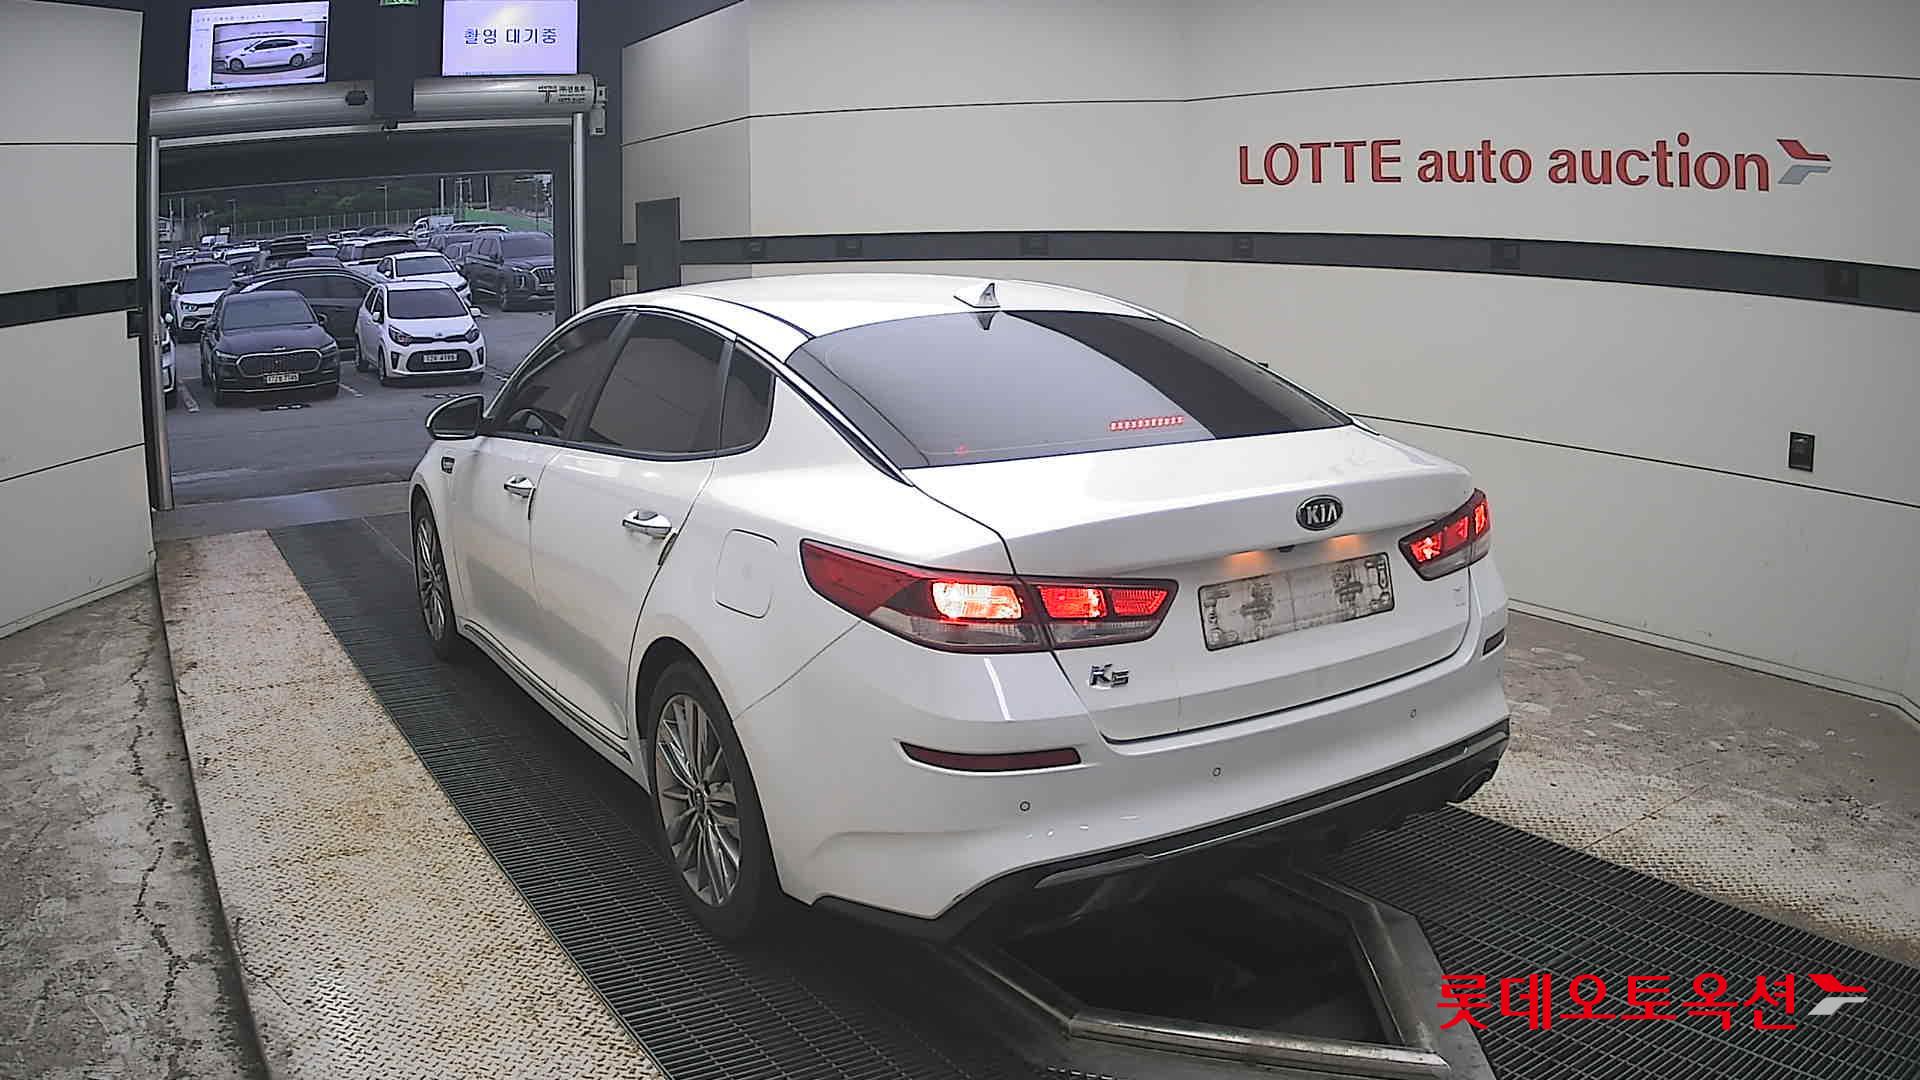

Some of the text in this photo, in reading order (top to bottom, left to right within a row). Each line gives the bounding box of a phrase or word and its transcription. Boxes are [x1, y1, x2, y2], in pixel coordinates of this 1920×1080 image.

[505, 27, 558, 45] 대기중
[1239, 132, 1771, 192] LOTTE auto auction
[1304, 502, 1338, 525] KIA
[1089, 663, 1129, 688] K5
